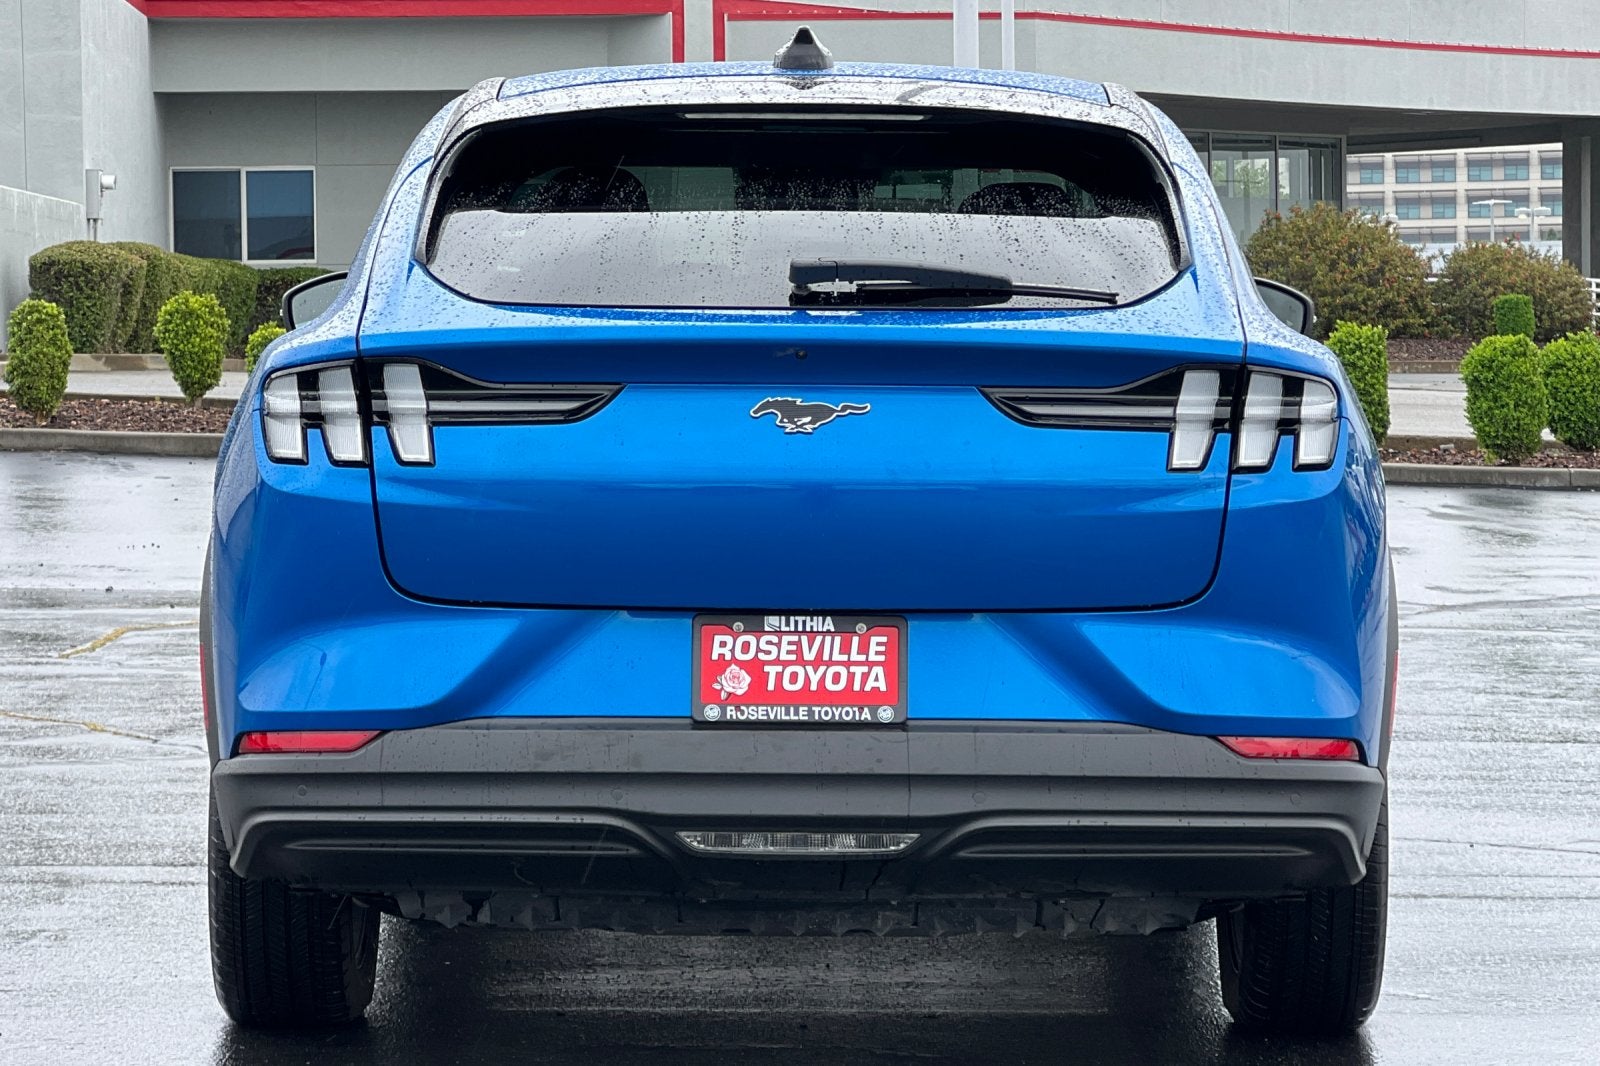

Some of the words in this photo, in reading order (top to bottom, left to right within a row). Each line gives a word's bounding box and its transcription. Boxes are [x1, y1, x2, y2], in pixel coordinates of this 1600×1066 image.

[779, 616, 835, 632] LITHIA
[711, 635, 888, 662] ROSEVILLE
[764, 665, 888, 692] TOYOTA
[726, 706, 808, 720] ROSEVILLE
[812, 706, 872, 721] TOYOTA
